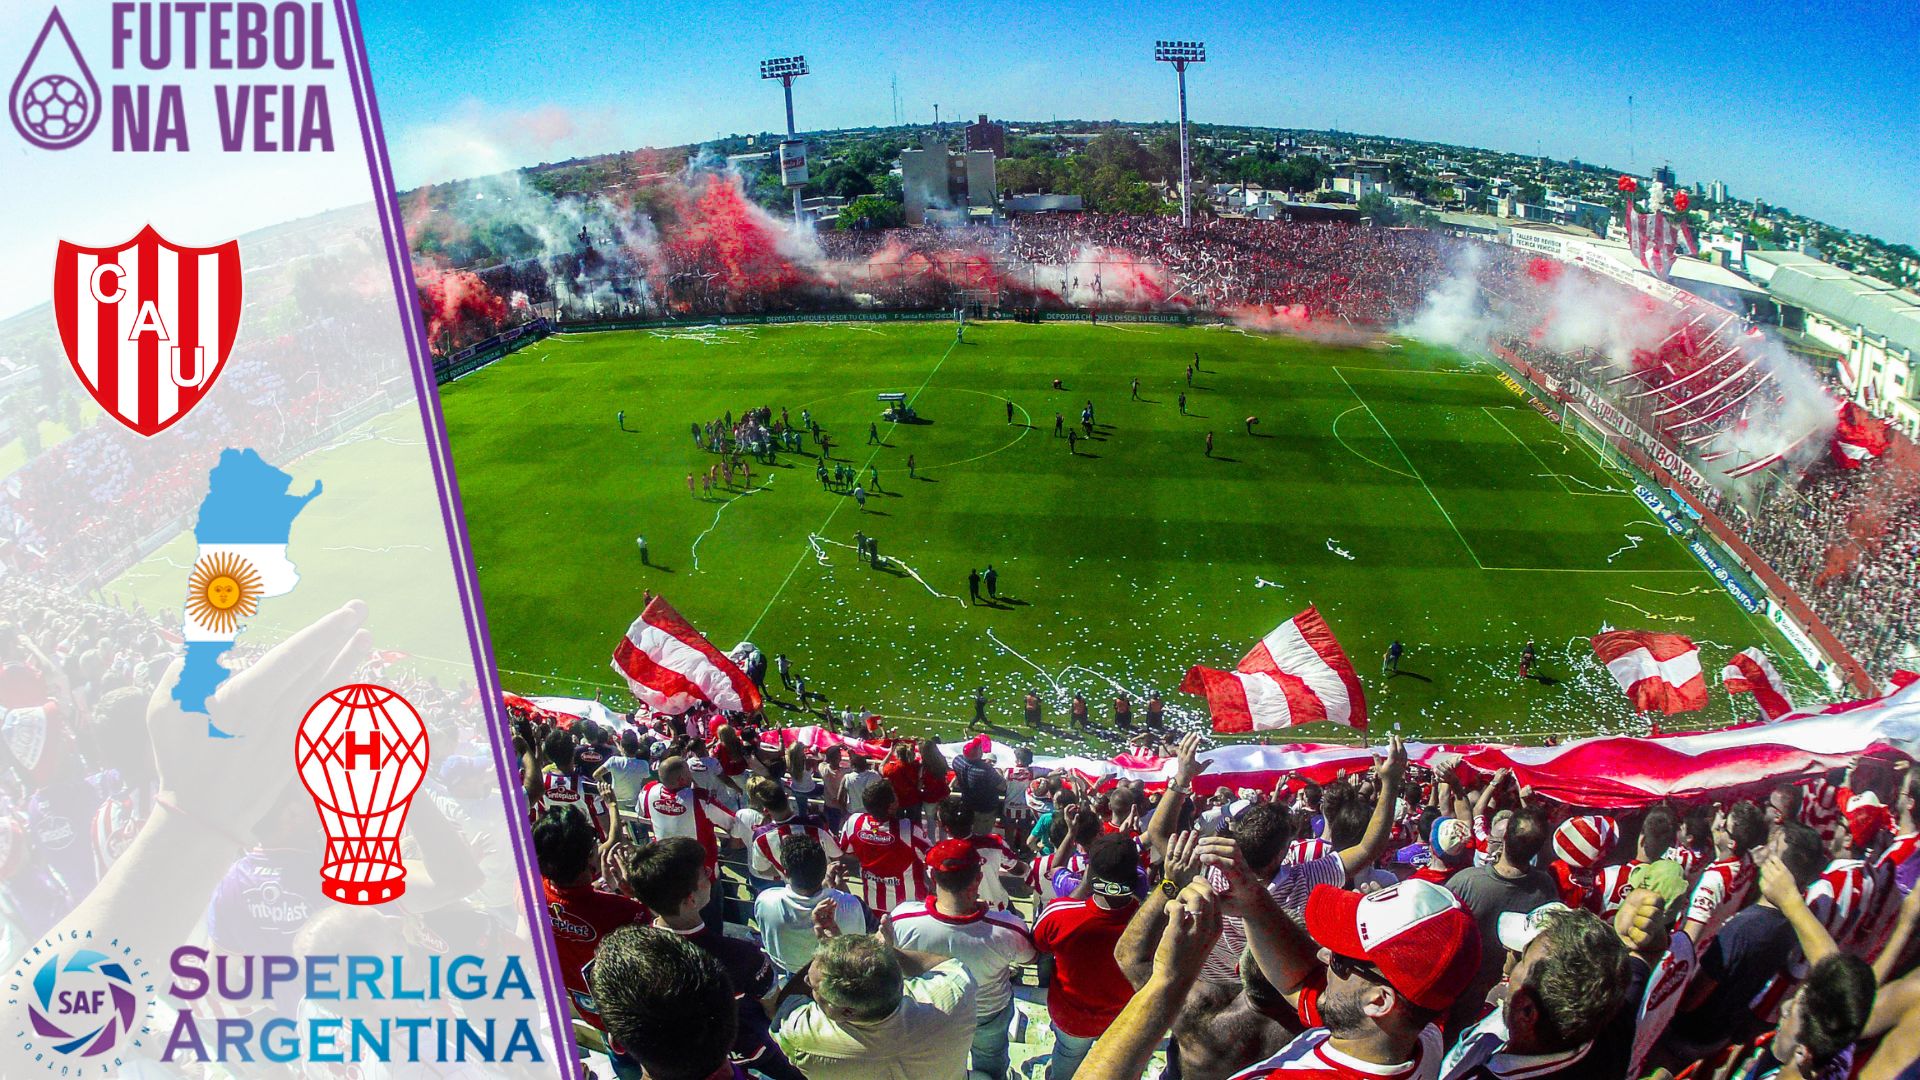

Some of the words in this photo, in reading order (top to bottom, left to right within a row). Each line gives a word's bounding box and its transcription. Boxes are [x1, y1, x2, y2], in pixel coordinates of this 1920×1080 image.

[1690, 542, 1717, 570] Allianz
[1725, 579, 1755, 611] Seguros
[546, 791, 578, 801] Sinteplast
